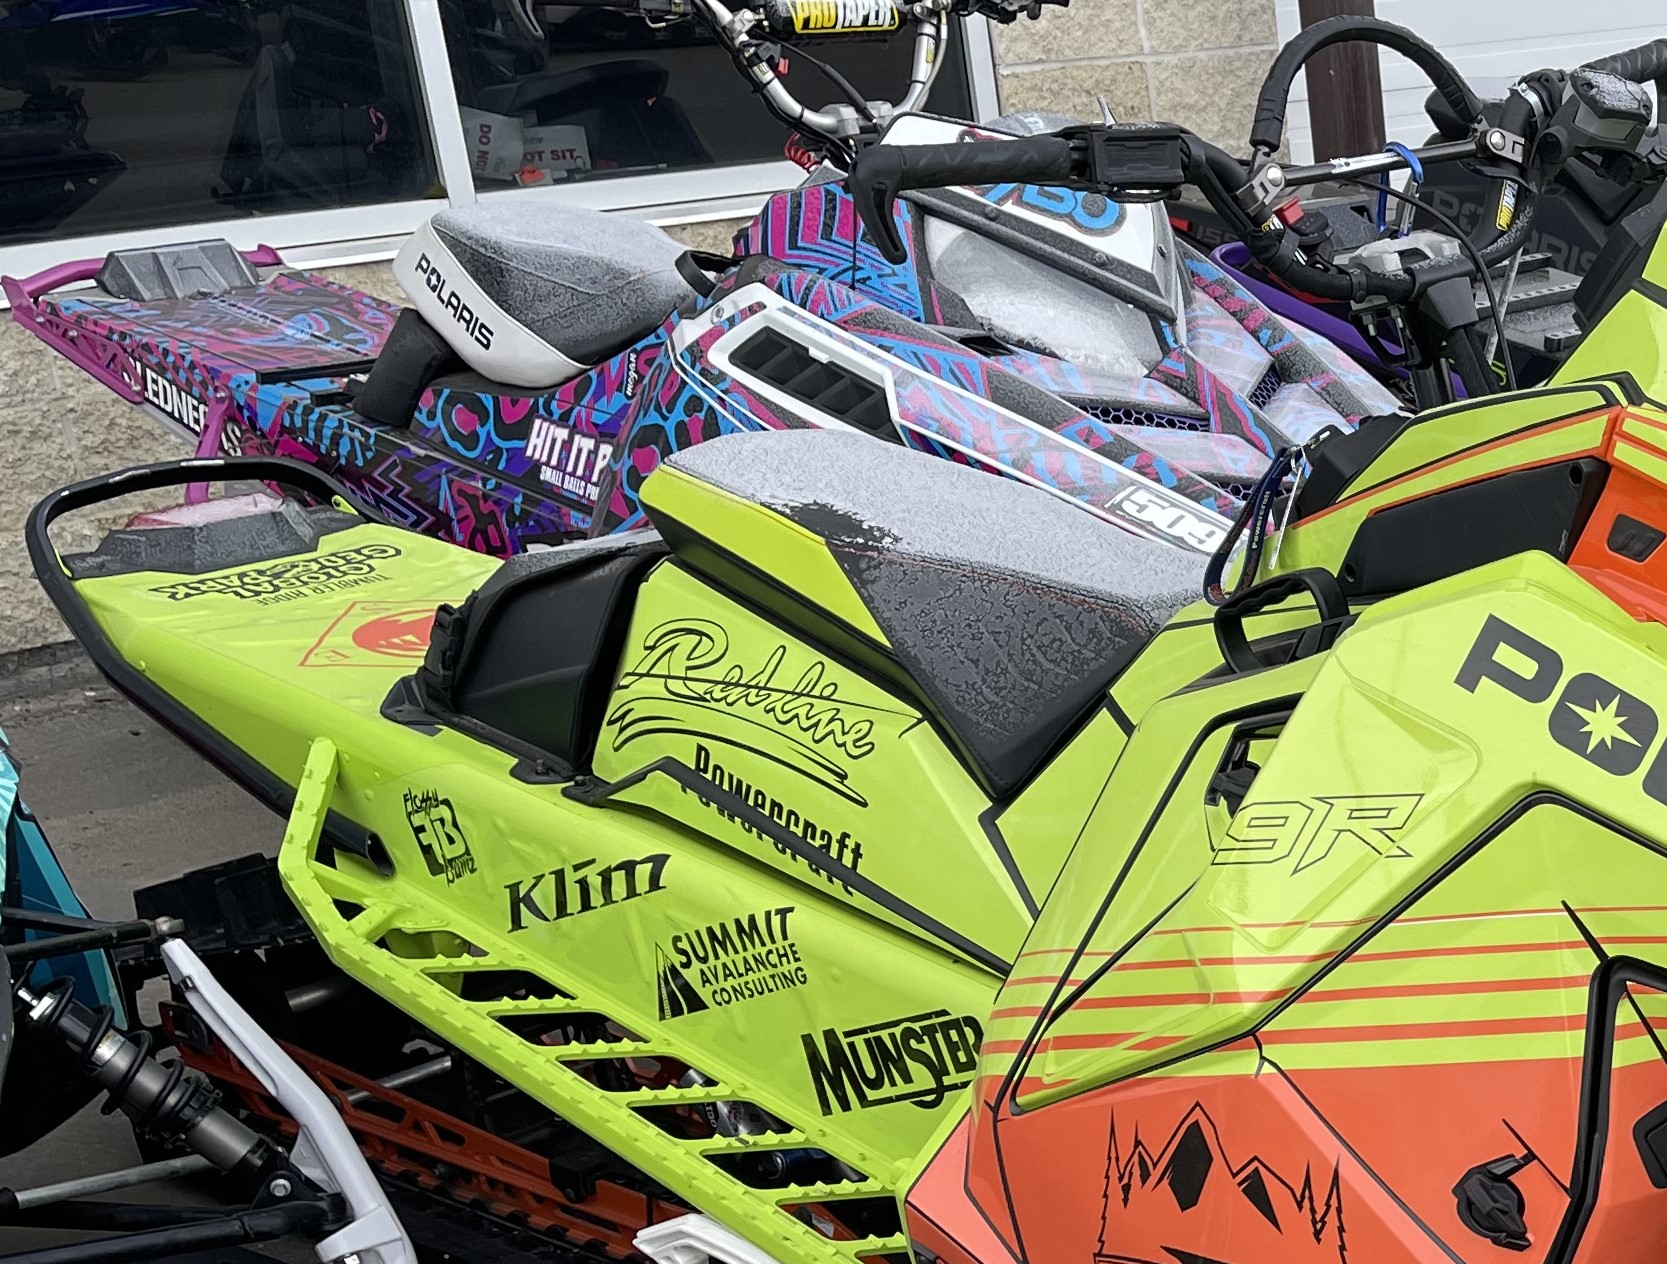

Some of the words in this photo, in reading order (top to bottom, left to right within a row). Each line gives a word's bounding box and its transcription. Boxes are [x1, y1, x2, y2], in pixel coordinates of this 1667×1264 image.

[479, 124, 492, 145] DO
[523, 151, 545, 162] OT
[551, 148, 577, 161] SIT
[415, 252, 494, 351] POLARIS
[525, 418, 569, 467] HIT
[566, 434, 596, 477] IT
[540, 466, 563, 487] SMALL
[563, 474, 586, 496] BALLS
[1121, 487, 1228, 554] 509
[218, 562, 376, 600] GLOBAL
[1211, 793, 1425, 877] 9R
[672, 906, 795, 970] SUMMIT
[699, 942, 801, 988] AVALANCHE
[711, 967, 807, 1006] CONSULTING
